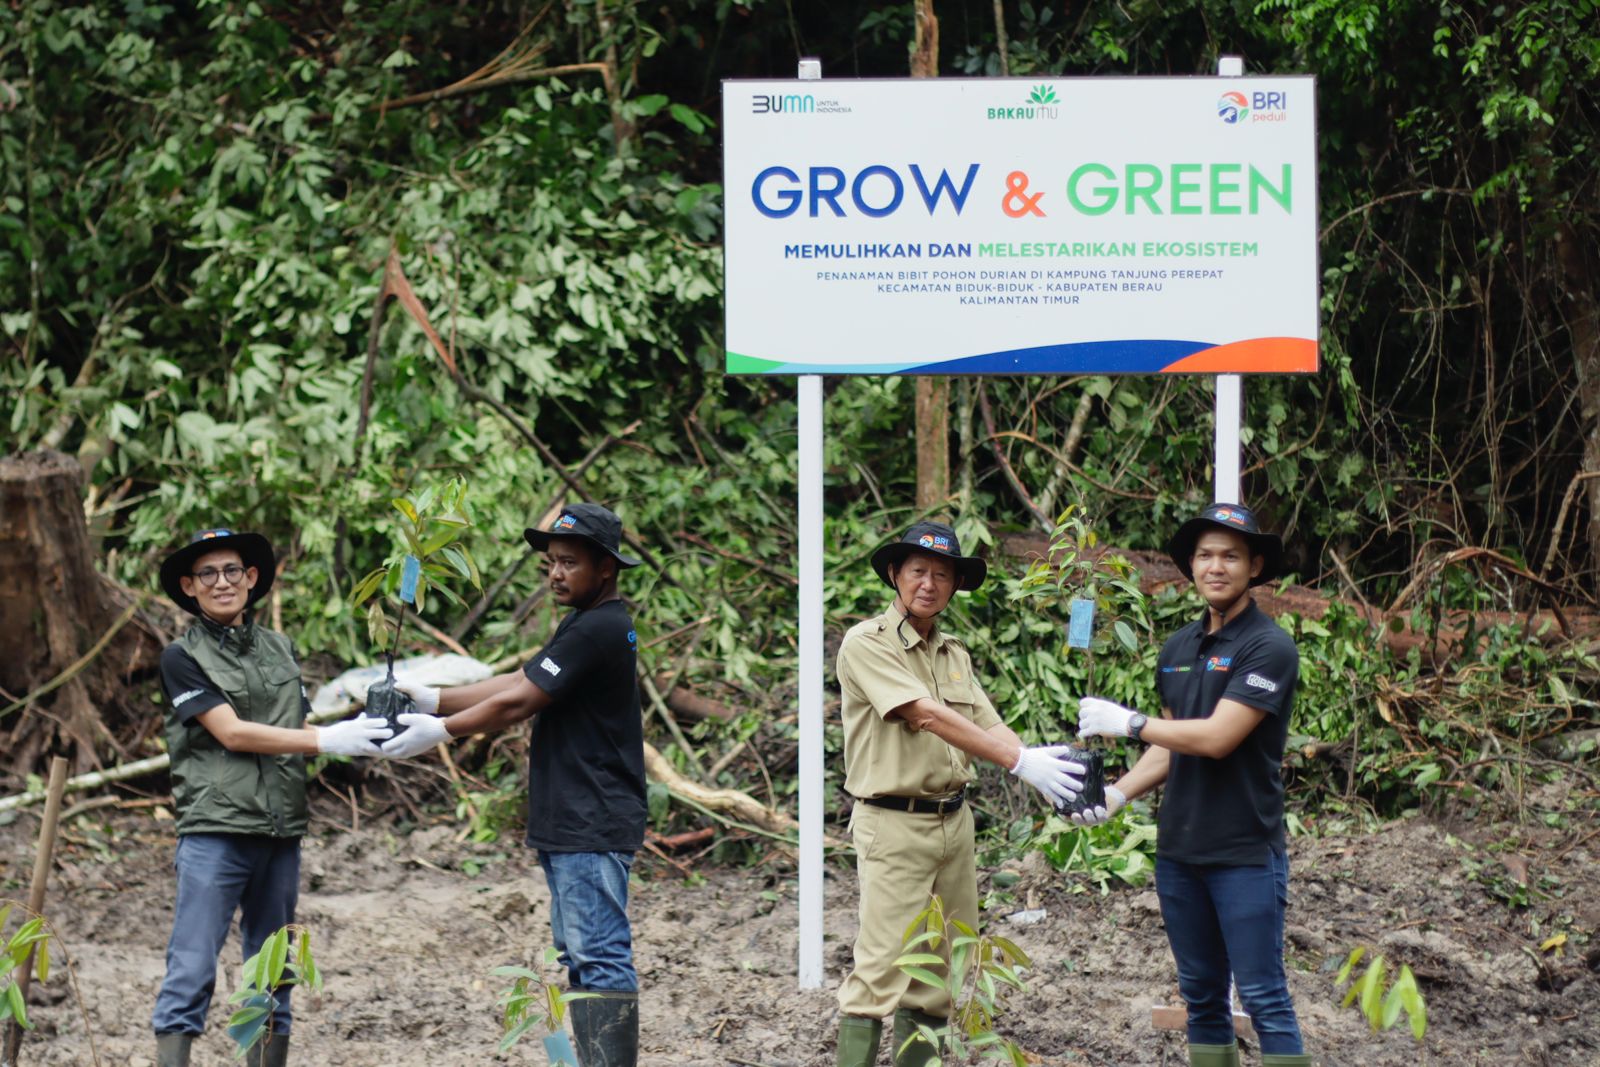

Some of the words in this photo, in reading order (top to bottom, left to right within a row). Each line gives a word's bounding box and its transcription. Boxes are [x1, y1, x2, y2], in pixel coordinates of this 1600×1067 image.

[1253, 92, 1286, 110] BRI
[1253, 112, 1287, 123] peduli
[752, 164, 980, 219] GROW
[1002, 171, 1046, 218] &
[1067, 163, 1292, 216] GREEN
[785, 244, 921, 258] MEMULIHKAN
[929, 243, 971, 257] DAN
[979, 242, 1136, 257] MELESTARIKAN
[1143, 242, 1258, 256] EKOSISTEM
[816, 271, 894, 281] PENANAMAN
[897, 270, 929, 281] BIBIT
[932, 270, 976, 280] POHON
[980, 270, 1027, 280] DURIAN
[1030, 270, 1043, 280] DI
[1046, 269, 1107, 280] KAMPUNG
[1110, 269, 1168, 280] TANJUNG
[1171, 269, 1224, 279] PEREPAT
[877, 283, 952, 293] KECAMATAN
[955, 282, 1035, 293] BIDUK-BIDUK
[1046, 282, 1118, 293] KABUPATEN
[1121, 282, 1163, 292] BERAU
[959, 295, 1039, 305] KALIMANTAN
[1042, 295, 1080, 305] TIMUR
[934, 536, 949, 546] BRI
[1259, 677, 1276, 692] BRI
